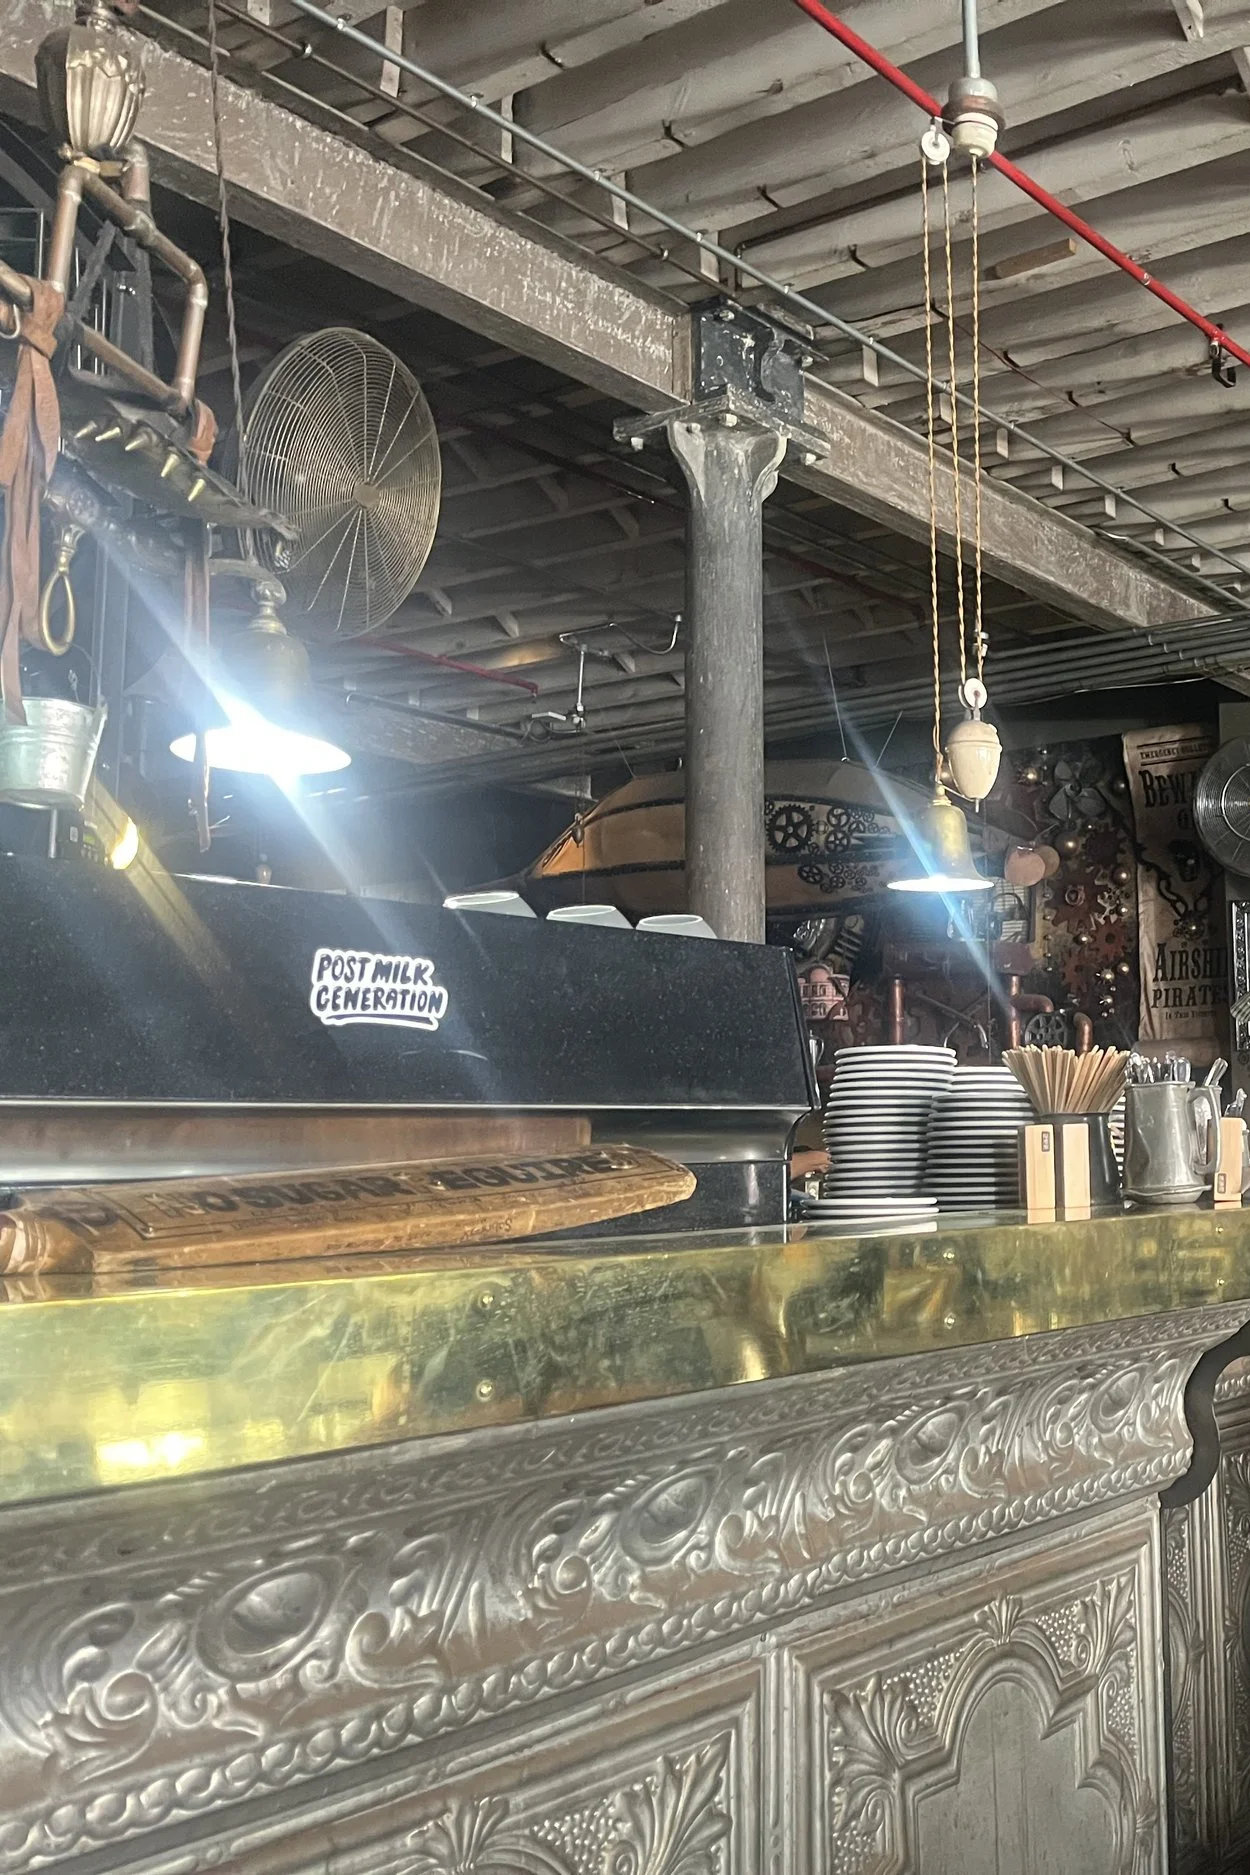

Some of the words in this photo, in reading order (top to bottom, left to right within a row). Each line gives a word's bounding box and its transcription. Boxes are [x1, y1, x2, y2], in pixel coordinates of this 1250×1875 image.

[316, 953, 371, 983] POST
[371, 958, 430, 986] MILK
[1152, 942, 1229, 982] AIRSHI
[316, 984, 444, 1014] GENERATION
[230, 1171, 418, 1209] SUGAR
